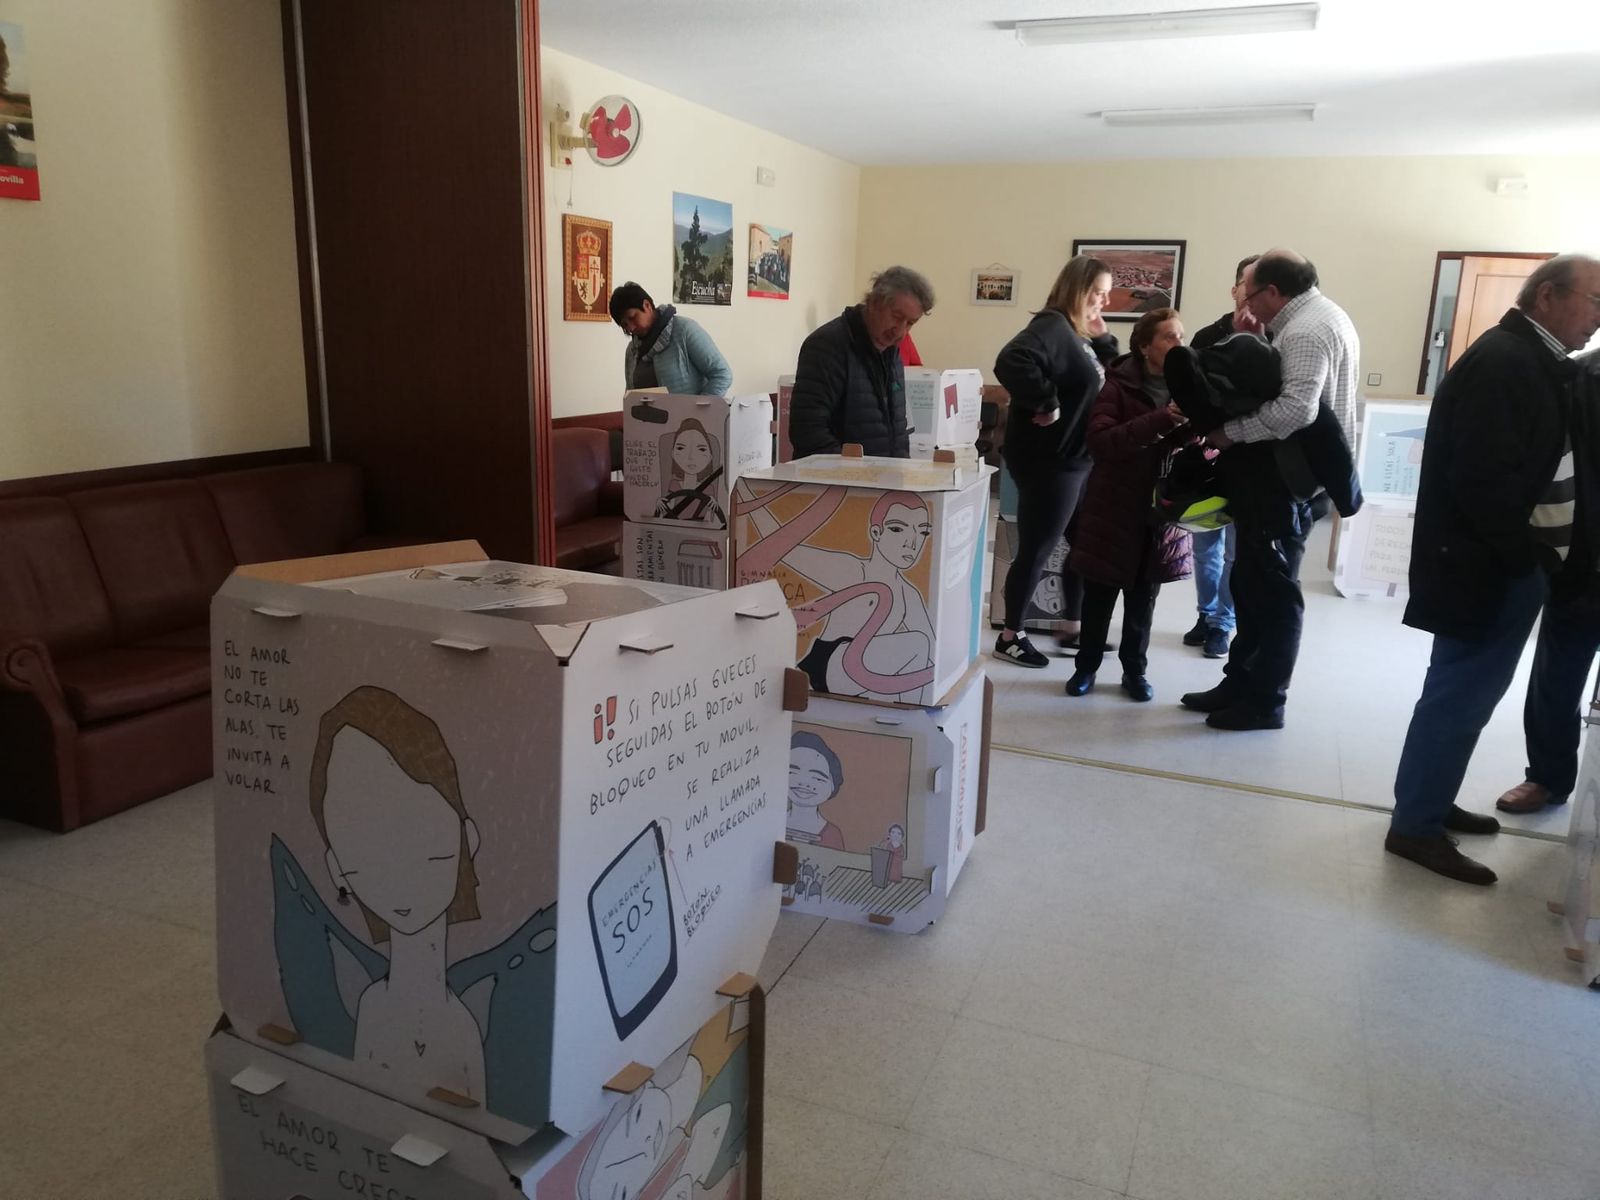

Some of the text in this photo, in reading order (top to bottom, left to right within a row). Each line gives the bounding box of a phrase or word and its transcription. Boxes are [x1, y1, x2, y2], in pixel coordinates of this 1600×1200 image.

[224, 640, 292, 665] EL AMOR
[224, 664, 268, 686] NO TE
[224, 688, 300, 716] CORTA LAS
[605, 720, 674, 768] SEGUIDAS
[684, 711, 699, 732] EL
[754, 678, 768, 699] DE
[628, 698, 640, 725] SI
[651, 678, 698, 717] PULSAS
[266, 723, 287, 741] TE
[224, 770, 277, 795] VOLAR
[227, 747, 291, 771] INVITA A
[590, 766, 657, 816] BLOQUEO
[668, 751, 686, 771] EN
[695, 740, 711, 758] TU
[686, 744, 760, 800] SE REALIZA
[685, 775, 761, 832] UNA LLAMADA
[686, 791, 767, 862] A EMERGENCIAS
[612, 886, 654, 954] SOS
[236, 1094, 391, 1174] EL AMOR TE
[260, 1130, 319, 1173] HACE
